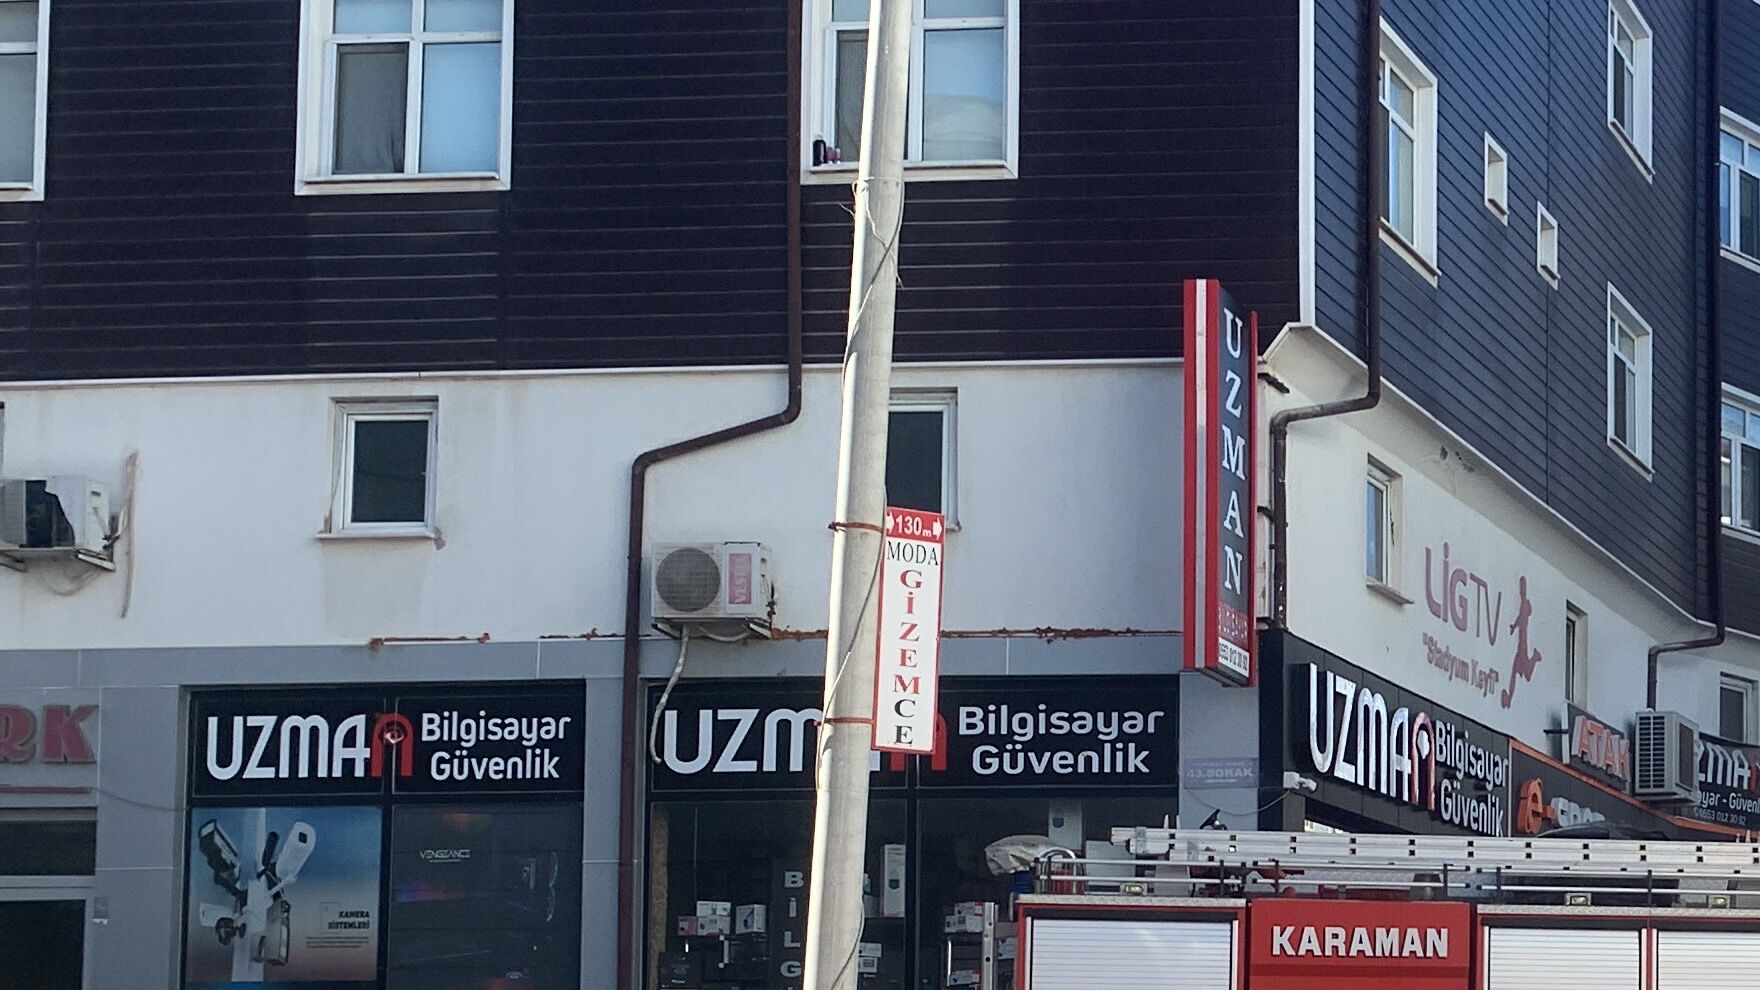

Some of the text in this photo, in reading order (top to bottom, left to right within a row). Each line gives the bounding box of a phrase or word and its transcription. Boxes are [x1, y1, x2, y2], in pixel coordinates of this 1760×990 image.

[1222, 307, 1248, 596] UZMAN
[886, 540, 939, 567] MODA
[421, 709, 572, 747] Bilgisayar
[958, 703, 1165, 742] Bilgisayar
[430, 748, 560, 782] Güvenlik
[972, 742, 1151, 776] Güvenlik
[1435, 719, 1509, 792] Bilgisayar
[1441, 778, 1504, 838] Güvenlik
[338, 911, 370, 919] KAMERA
[1272, 926, 1449, 958] KARAMAN
